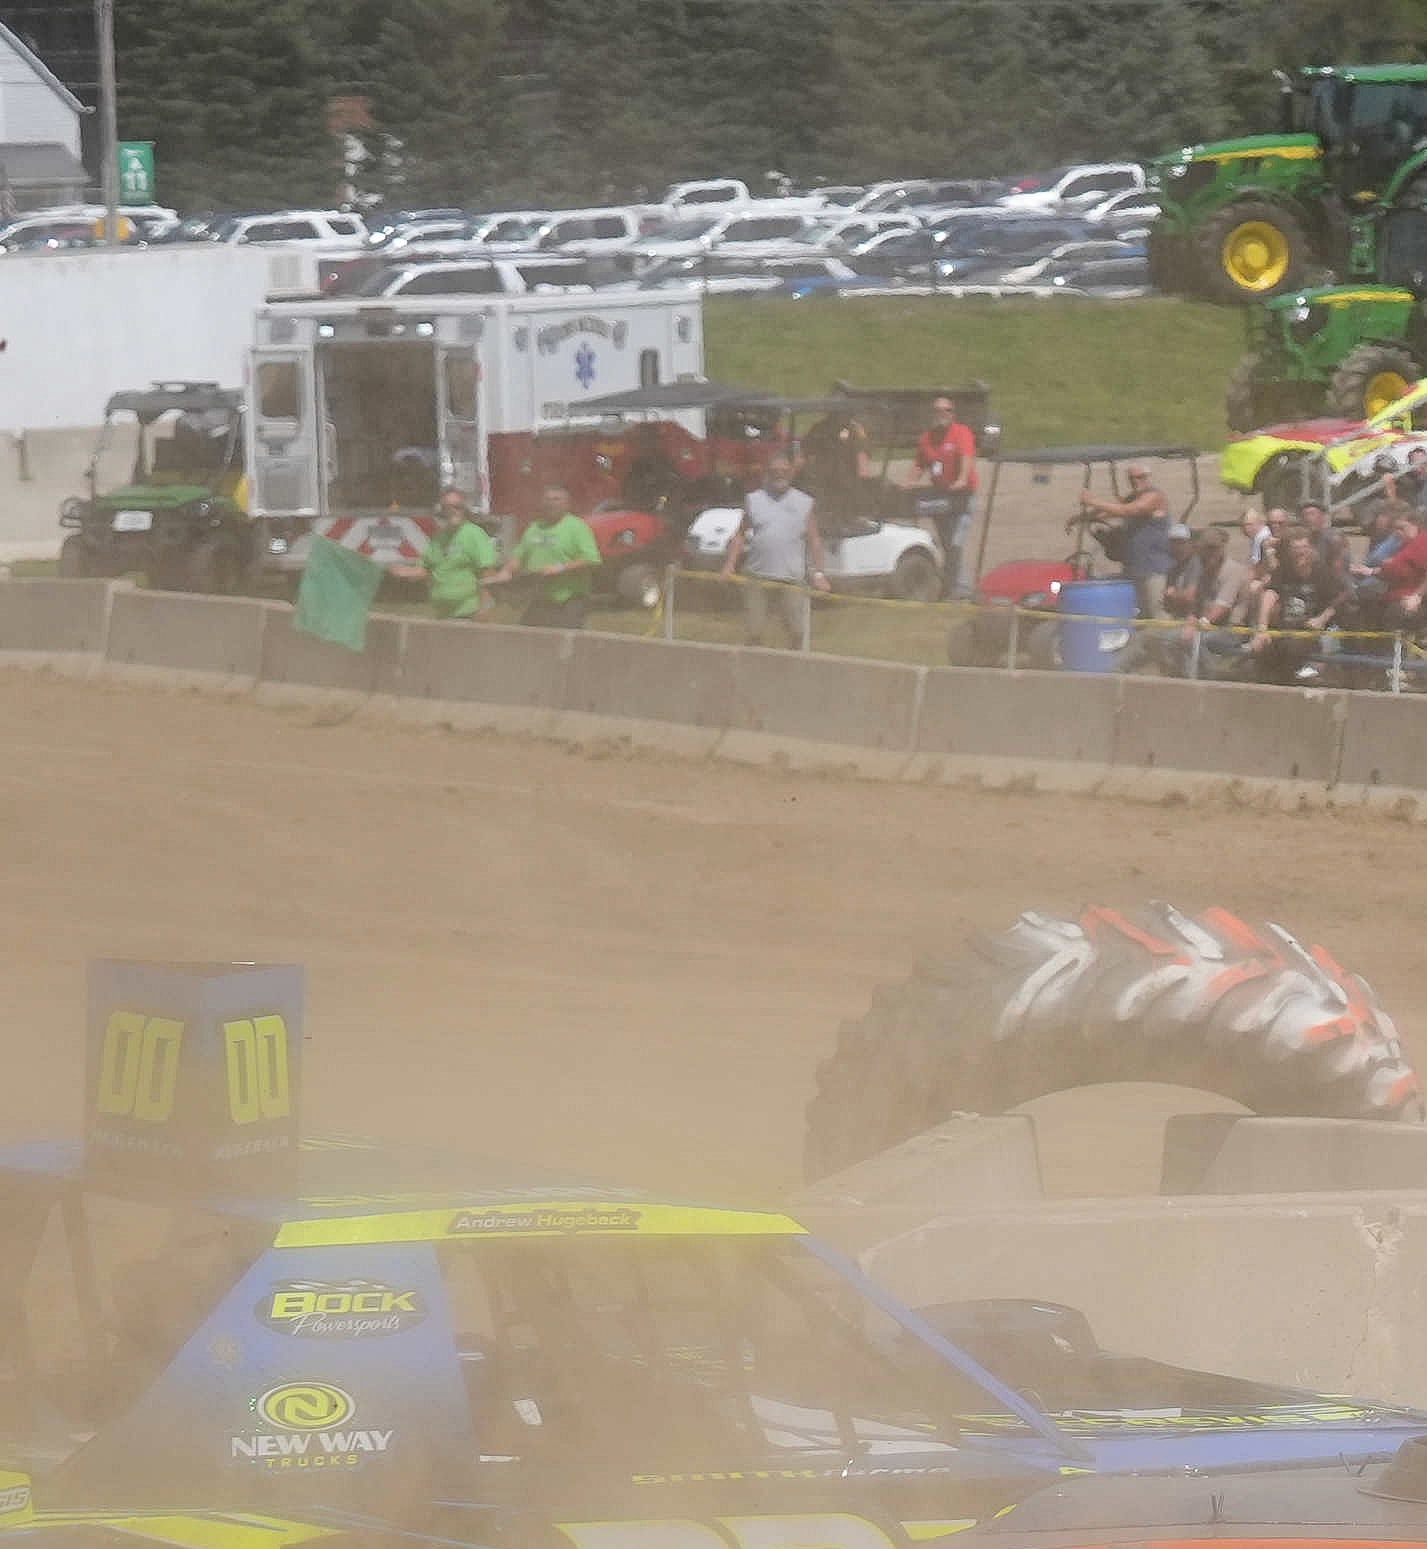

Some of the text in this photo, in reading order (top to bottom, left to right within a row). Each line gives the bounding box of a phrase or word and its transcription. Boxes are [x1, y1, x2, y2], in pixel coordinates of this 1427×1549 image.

[97, 1010, 184, 1121] 00
[223, 1014, 290, 1126] 00
[455, 1213, 533, 1230] Andrew
[270, 1290, 417, 1320] BOCK
[288, 1311, 401, 1337] Powersports
[230, 1430, 395, 1457] NEW WAY
[263, 1454, 361, 1469] TRUCKS
